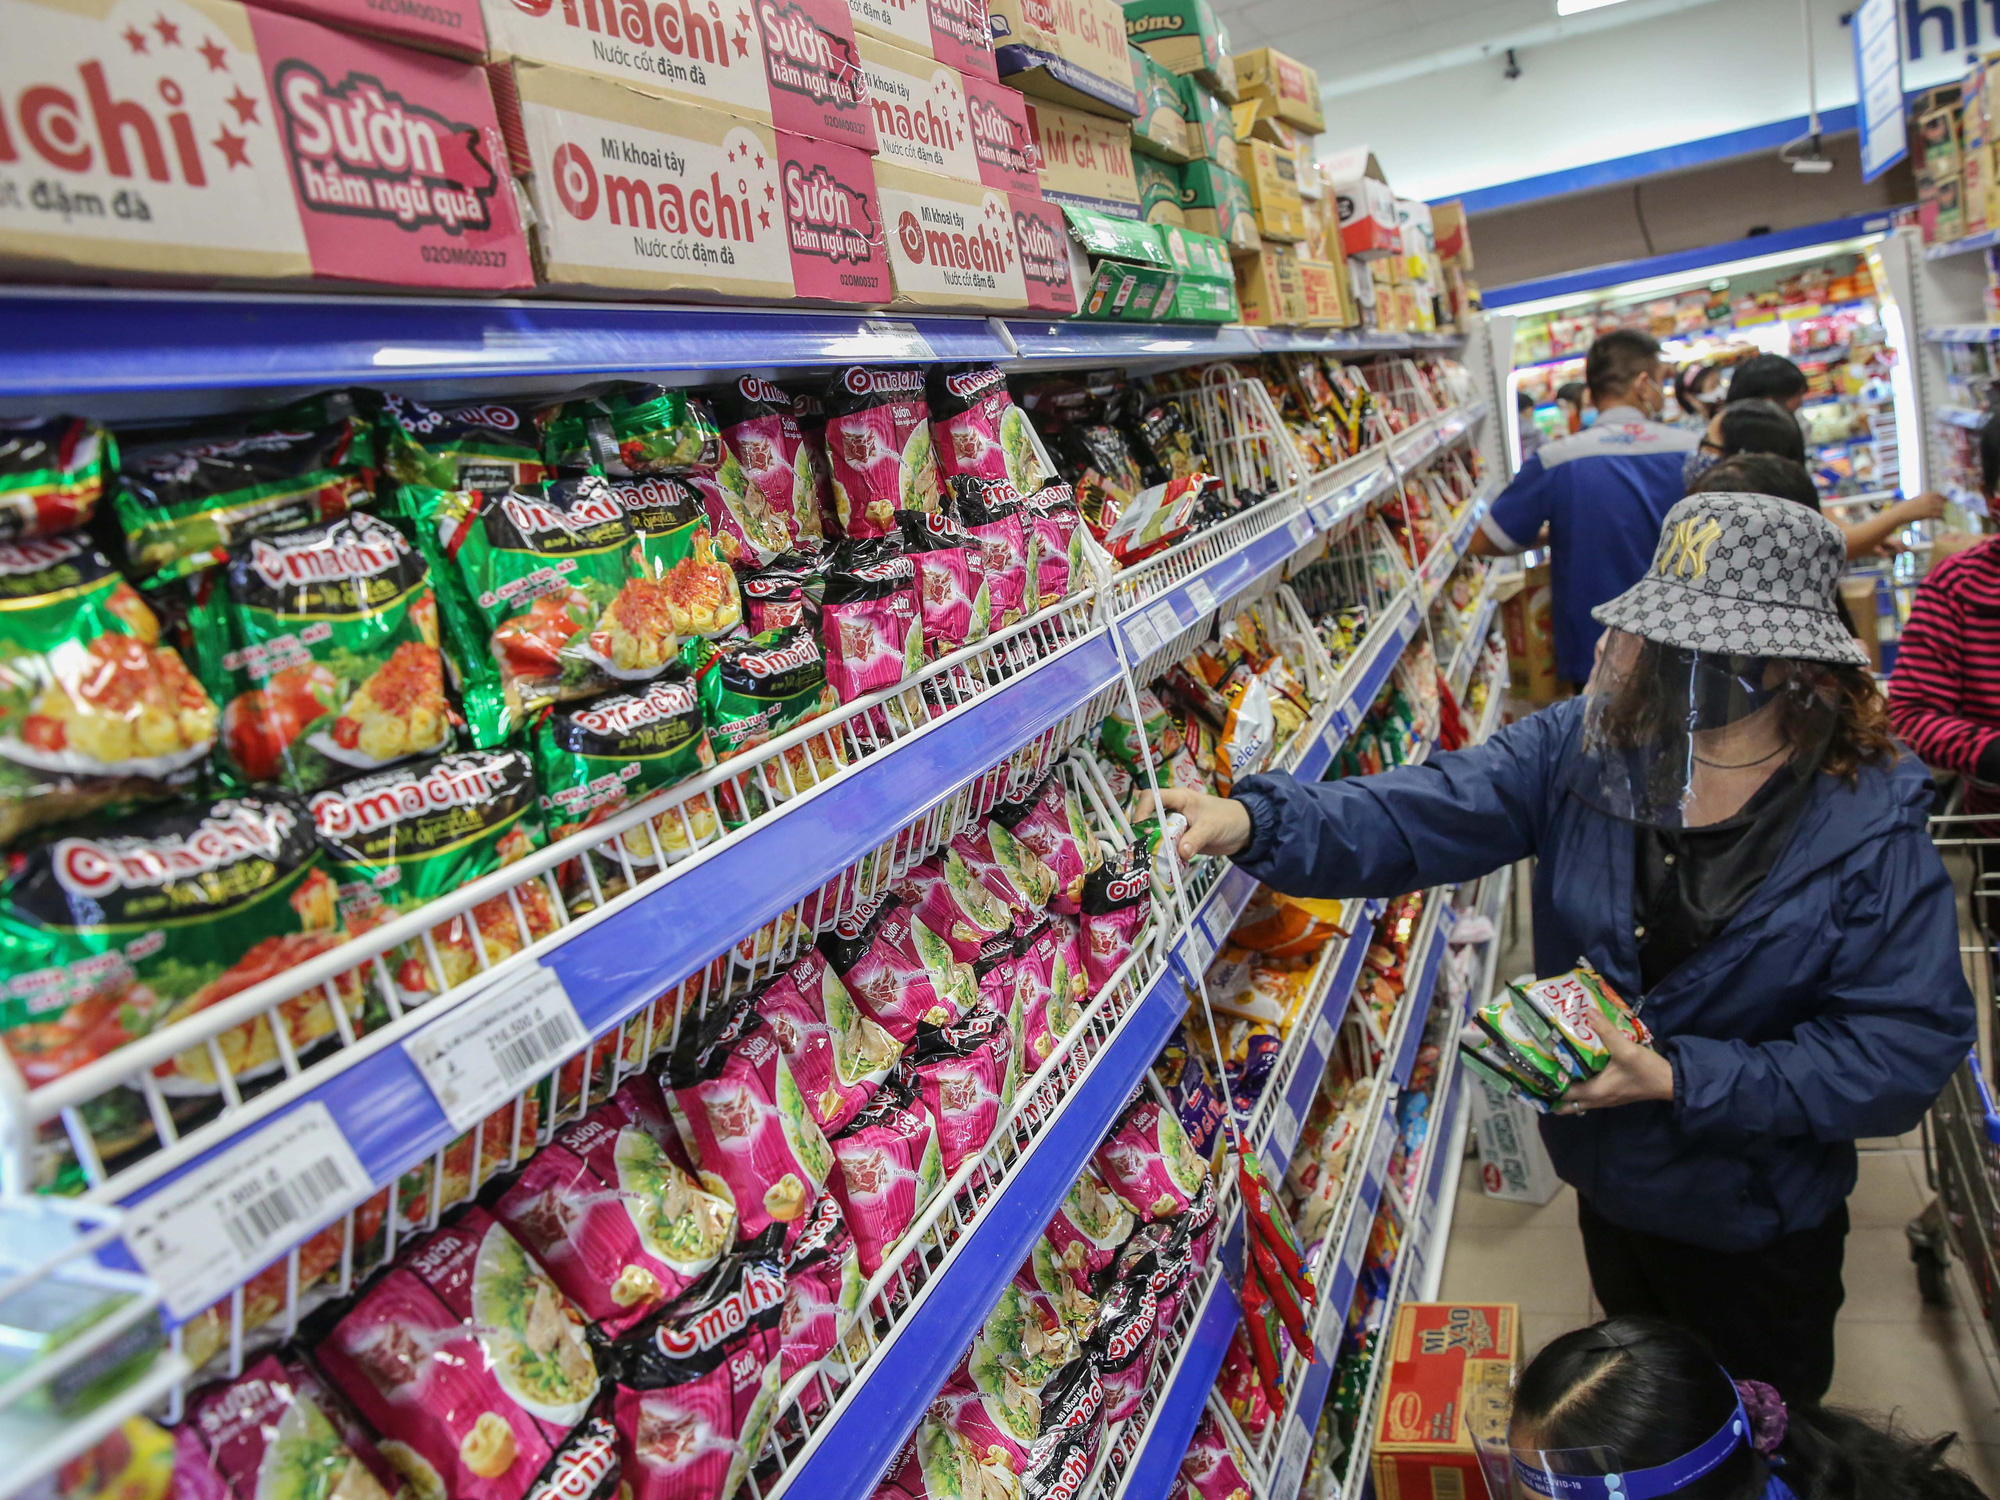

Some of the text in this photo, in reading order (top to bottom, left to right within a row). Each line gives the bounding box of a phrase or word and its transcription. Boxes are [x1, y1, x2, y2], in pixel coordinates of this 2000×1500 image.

[863, 2, 880, 21] đậm
[881, 9, 892, 25] đà
[1020, 0, 1053, 24] VIFON
[512, 0, 730, 68] machi
[761, 4, 835, 70] Sườn
[591, 39, 707, 86] Nước cốt đậm đà
[802, 68, 829, 97] ngũ
[873, 75, 897, 95] khoai
[897, 82, 910, 101] tây
[0, 60, 206, 187] achi
[284, 75, 445, 174] Sườn
[823, 114, 866, 135] 02OM00327
[871, 97, 955, 151] machi
[970, 101, 1014, 146] Sườn
[601, 137, 686, 177] Mì khoai tây
[882, 138, 944, 165] Nước cốt đậm đà
[1047, 116, 1068, 165] MÌ
[1072, 125, 1097, 171] GÀ
[29, 179, 105, 223] đậm
[112, 190, 153, 222] đà
[375, 177, 430, 223] ngũ
[433, 188, 484, 231] quả
[552, 142, 755, 243] Omachi
[785, 165, 850, 226] Sườn
[920, 206, 964, 230] Mì khoai tây
[420, 246, 508, 268] 02OM00327
[633, 236, 736, 267] Nước cốt đậm đà
[820, 231, 845, 257] ngũ
[898, 211, 1006, 273] Omachi
[1018, 219, 1055, 260] Sườn
[840, 273, 879, 288] 02OM00327
[943, 270, 996, 291] Nước cốt đậm đà
[892, 406, 912, 419] Sườn
[1659, 516, 1722, 580] NY
[720, 719, 747, 737] CHUA
[309, 762, 492, 839] Omachi
[881, 920, 901, 942] Sườn
[793, 961, 815, 985] Sườn
[1543, 985, 1592, 1041] CUNG
[562, 1120, 604, 1151] Sườn
[1133, 1111, 1151, 1129] Sườn
[412, 1236, 462, 1275] Sườn
